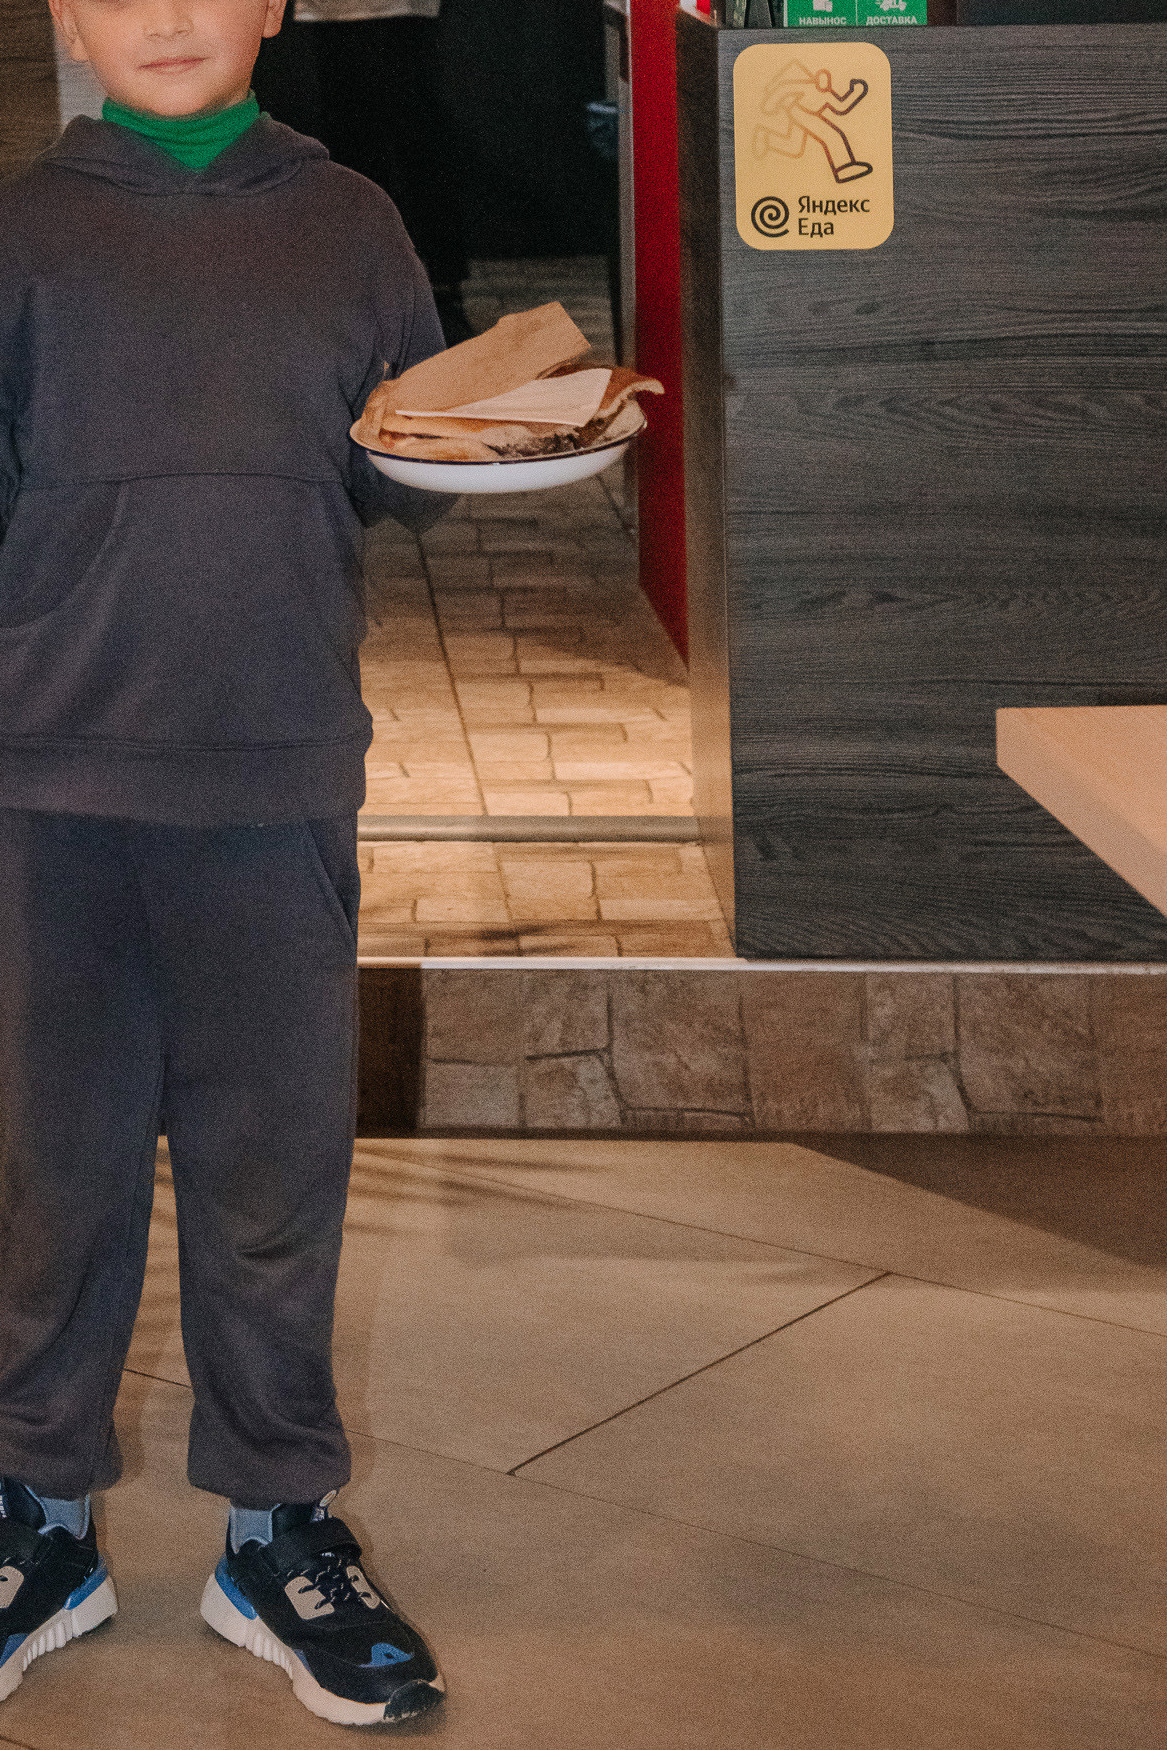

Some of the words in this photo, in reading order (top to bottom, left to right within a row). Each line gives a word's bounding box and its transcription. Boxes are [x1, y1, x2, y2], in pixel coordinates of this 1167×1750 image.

[798, 16, 847, 25] НАВЫНОС
[866, 16, 918, 26] ДОСТАВКА
[797, 195, 870, 215] Яндекс
[797, 217, 835, 238] Еда
